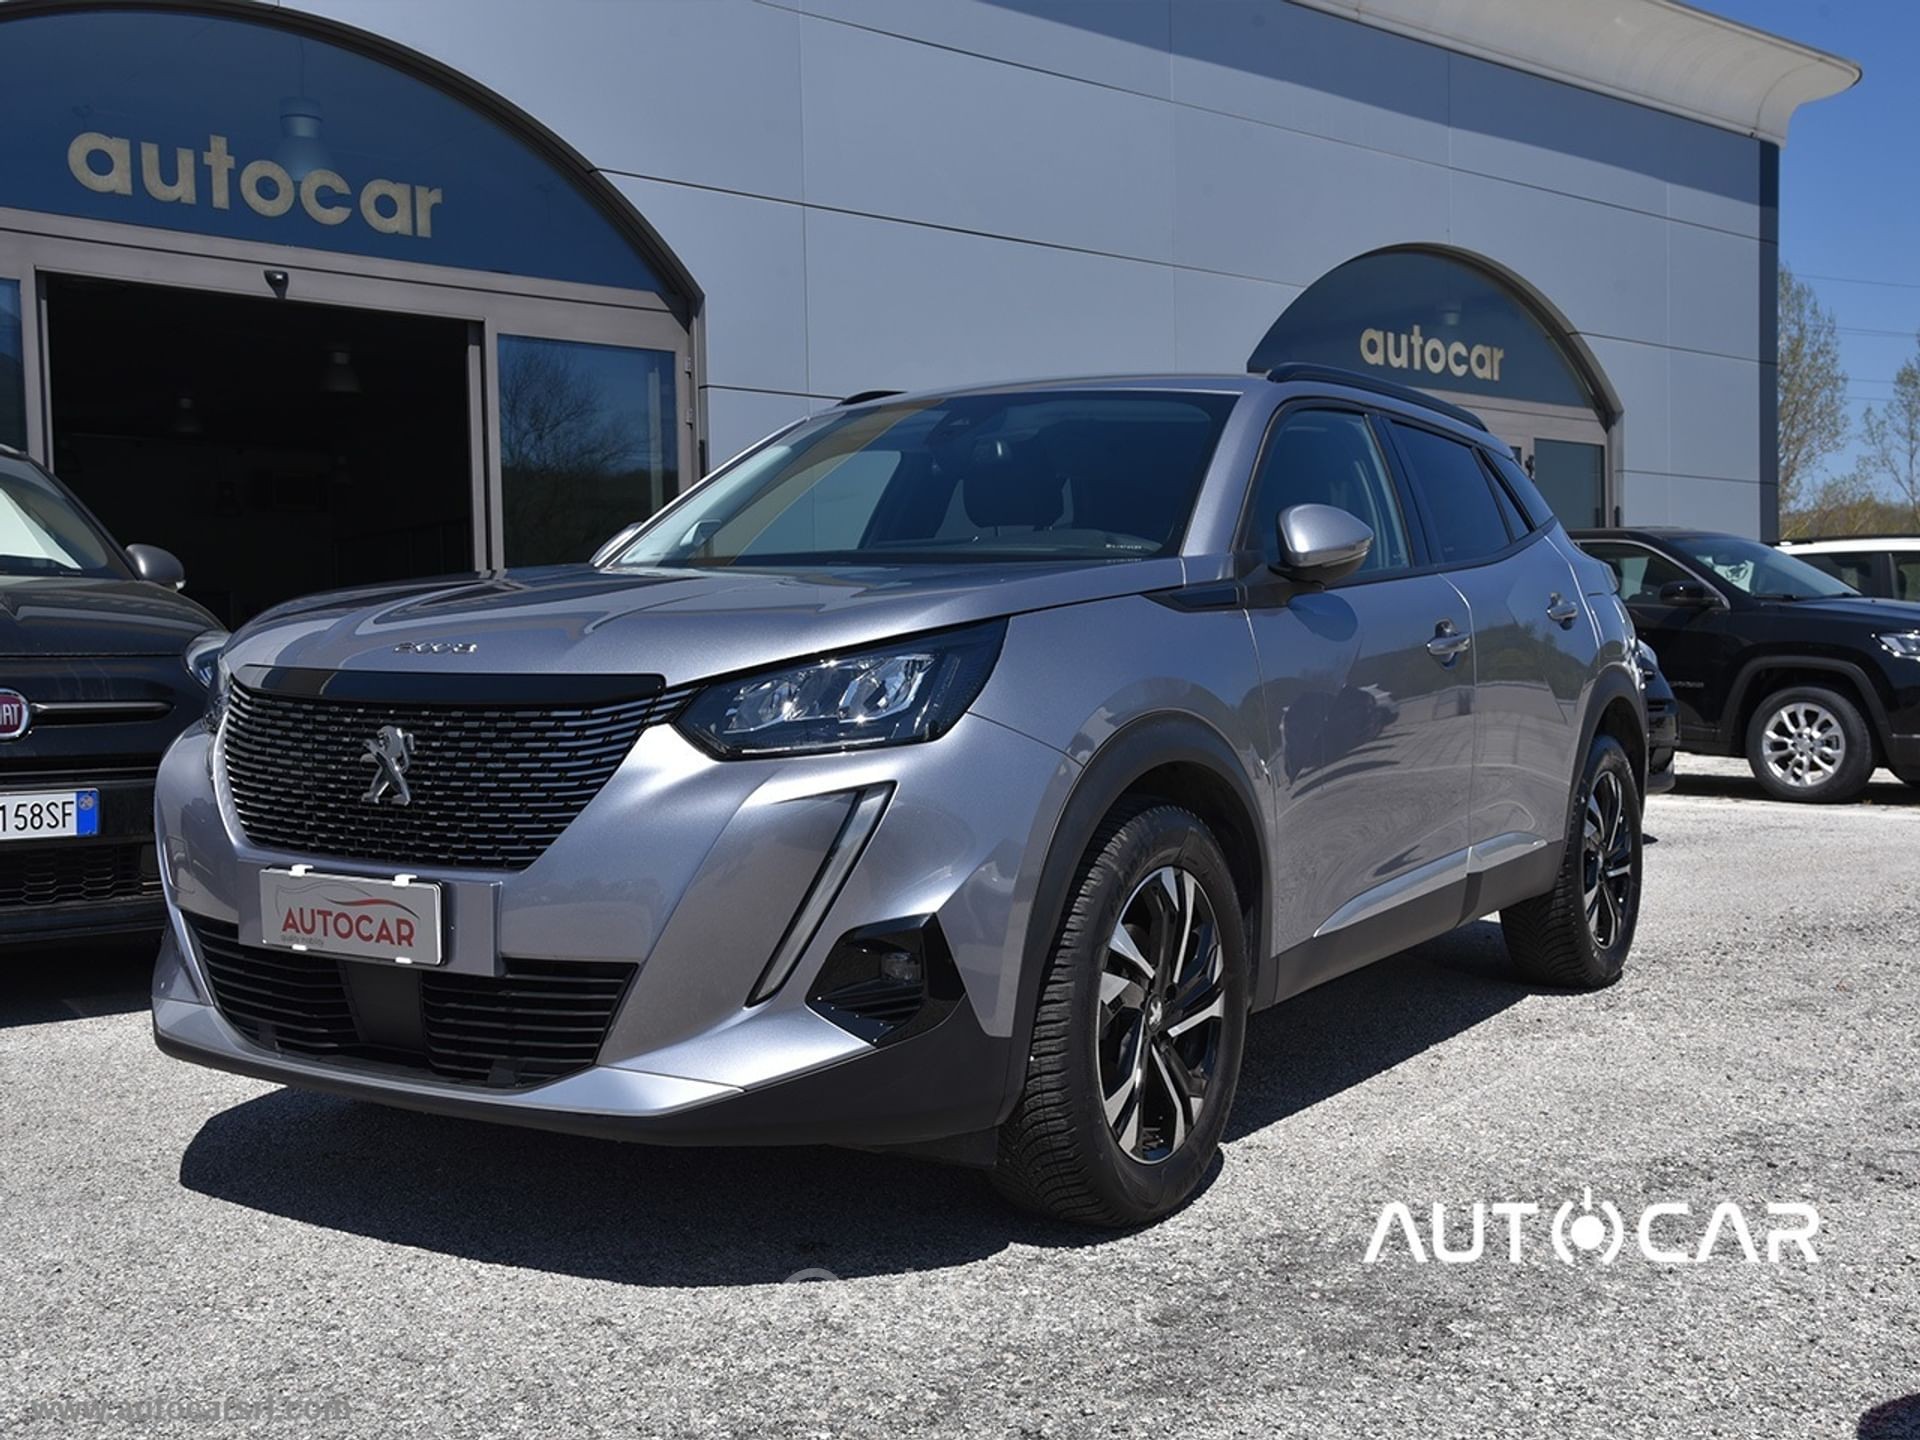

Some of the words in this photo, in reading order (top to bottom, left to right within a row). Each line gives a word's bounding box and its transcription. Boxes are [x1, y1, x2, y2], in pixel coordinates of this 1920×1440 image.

[67, 131, 443, 238] autocar
[1360, 324, 1504, 381] autocar
[282, 907, 415, 947] AUTOCAR
